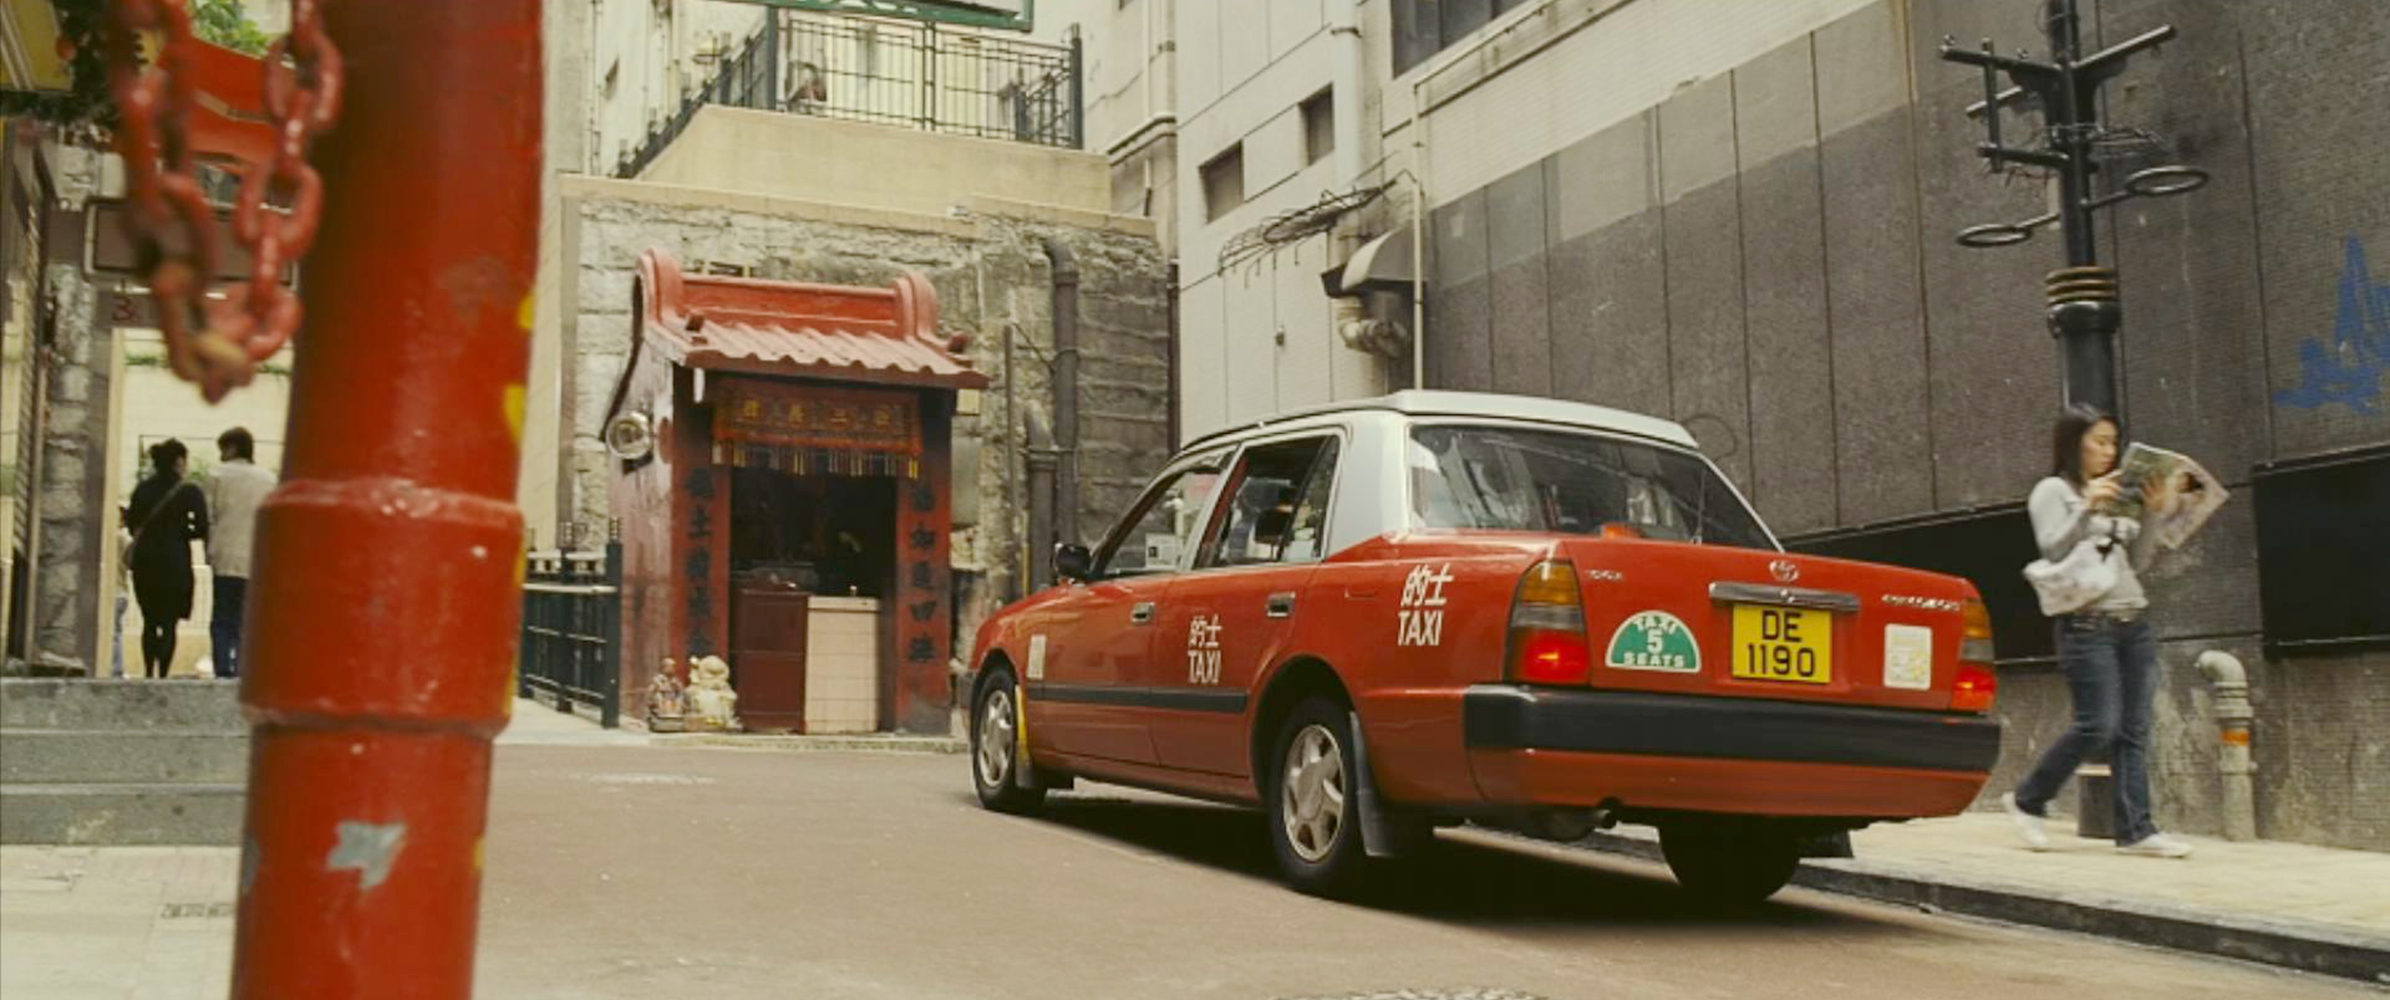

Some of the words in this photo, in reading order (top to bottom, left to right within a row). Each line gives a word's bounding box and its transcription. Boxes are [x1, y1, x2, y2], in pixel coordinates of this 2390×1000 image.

[1401, 563, 1453, 606] 的士
[1188, 615, 1222, 648] 的士
[1398, 610, 1442, 646] TAXI
[1633, 615, 1676, 634] TAXI
[1762, 610, 1802, 642] DE
[1647, 630, 1662, 654] 5
[1188, 650, 1221, 683] TAXI
[1624, 652, 1684, 668] SEATS
[1748, 644, 1815, 677] 1190
